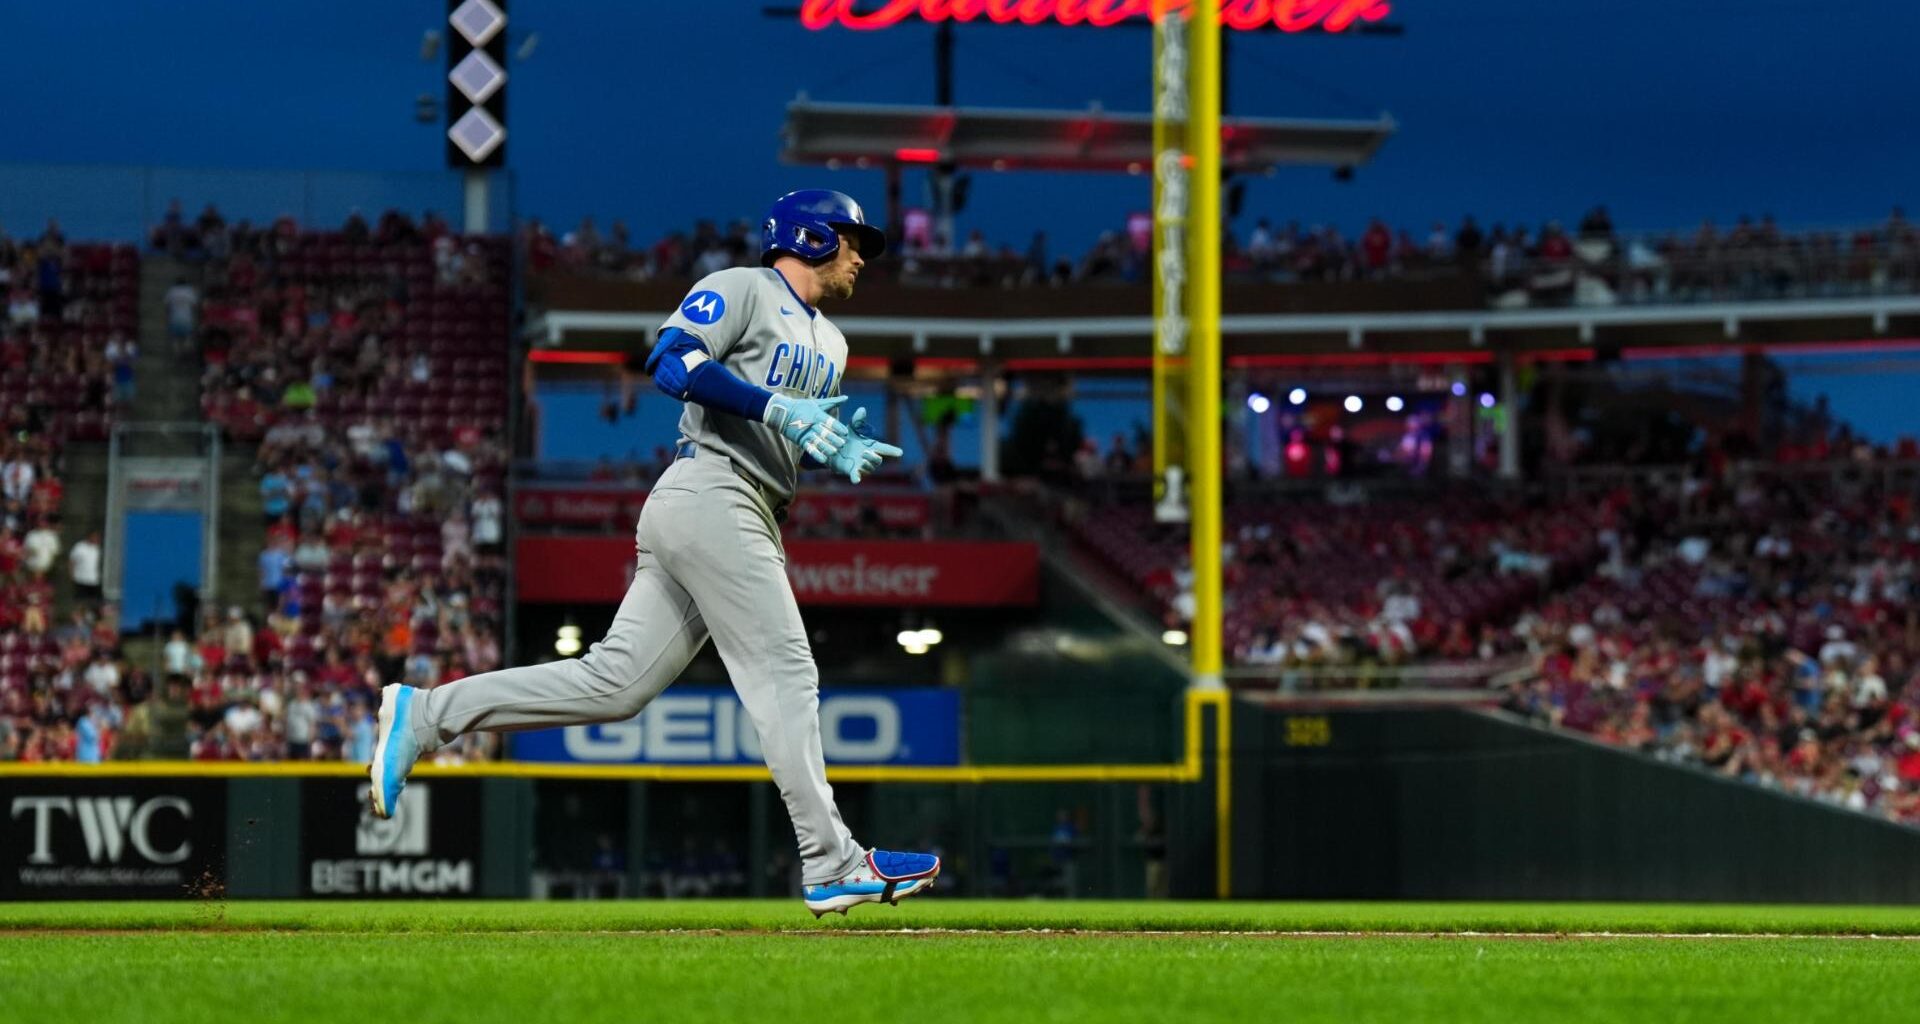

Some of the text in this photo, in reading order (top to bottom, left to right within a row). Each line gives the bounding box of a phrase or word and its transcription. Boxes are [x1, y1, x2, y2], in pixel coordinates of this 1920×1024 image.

[765, 342, 841, 400] CHICA
[11, 796, 191, 864] TWC
[311, 859, 472, 894] BETMGM
